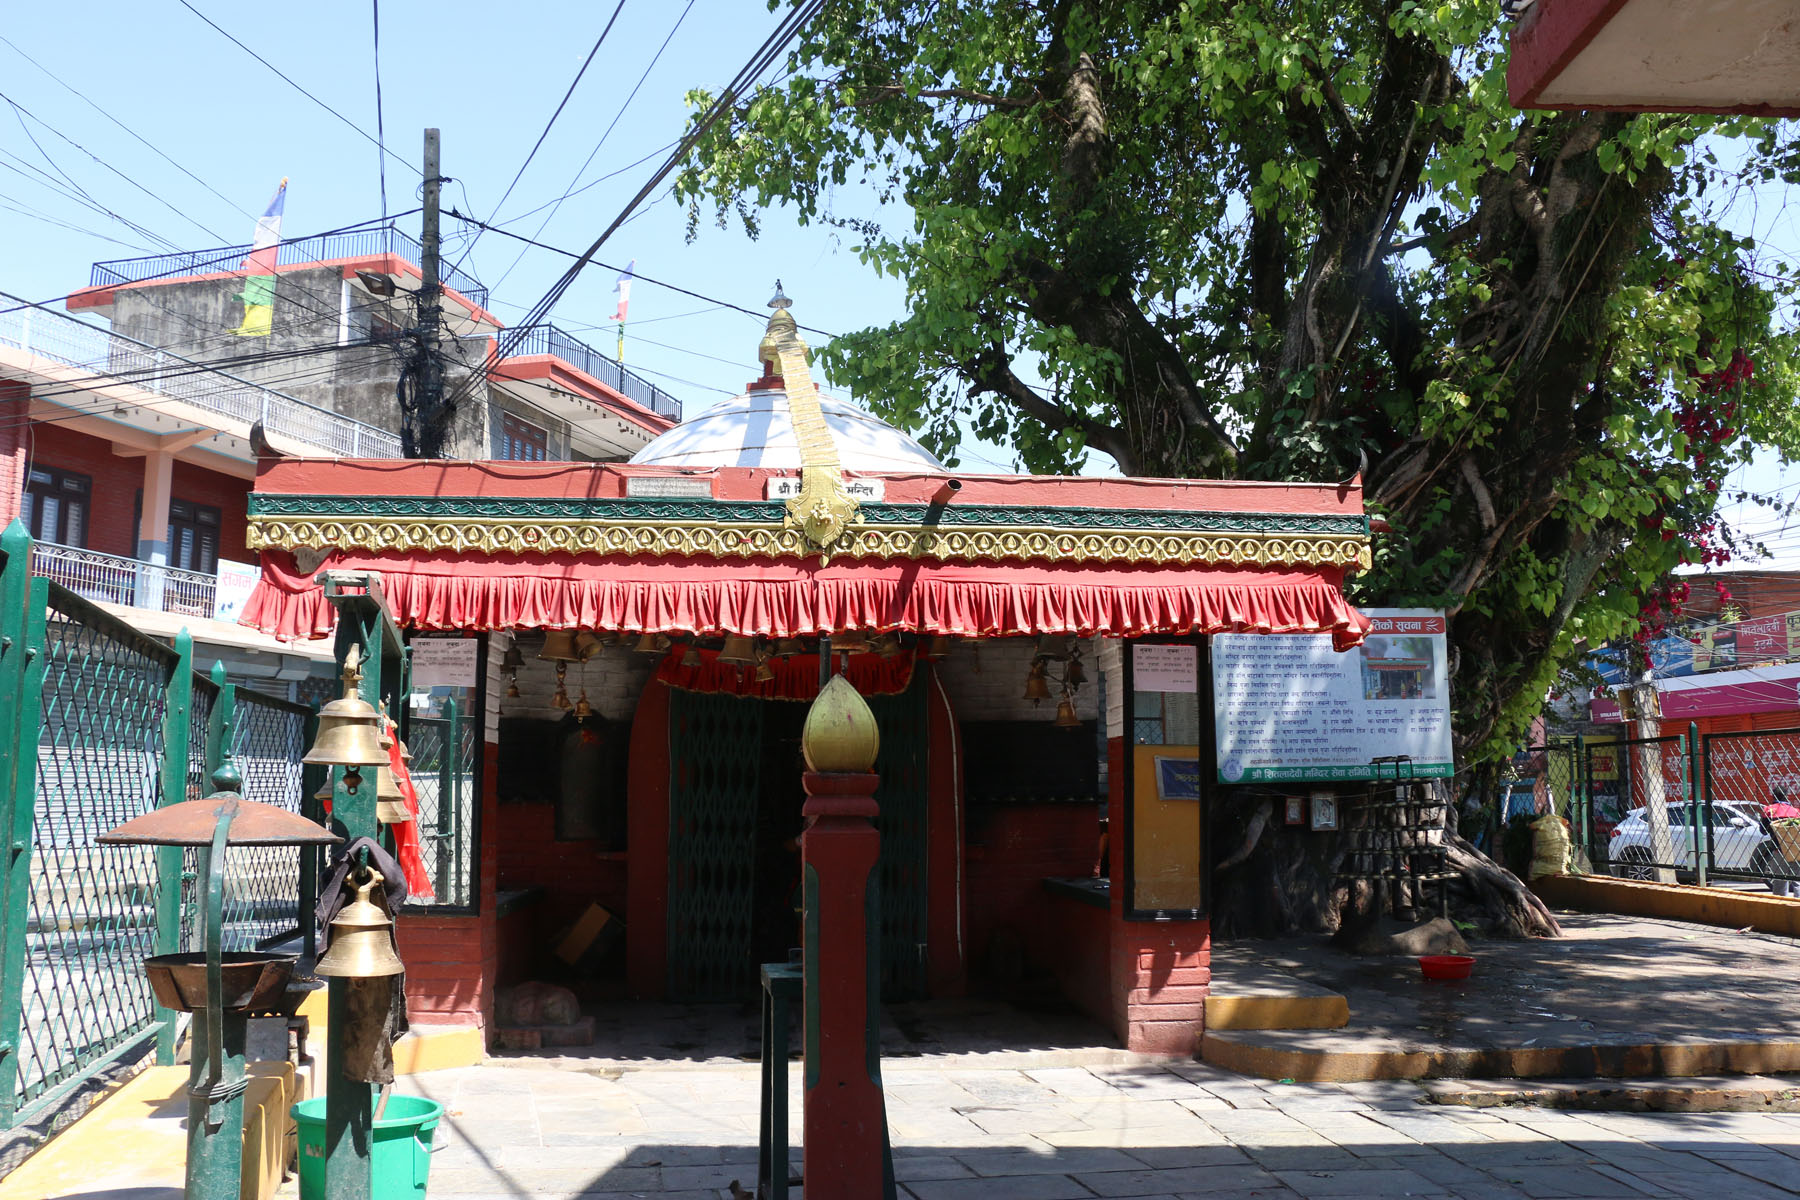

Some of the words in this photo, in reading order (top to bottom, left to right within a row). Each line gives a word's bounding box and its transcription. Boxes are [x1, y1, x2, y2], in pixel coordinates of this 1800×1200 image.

[777, 481, 791, 494] श्री
[845, 482, 874, 496] मन्दिर
[1371, 619, 1393, 631] तिको
[1396, 621, 1421, 632] सूचना
[1252, 770, 1262, 779] श्री
[1264, 768, 1302, 779] शितलादेवी
[1305, 768, 1329, 778] मन्दिर
[1331, 768, 1346, 777] सेवा
